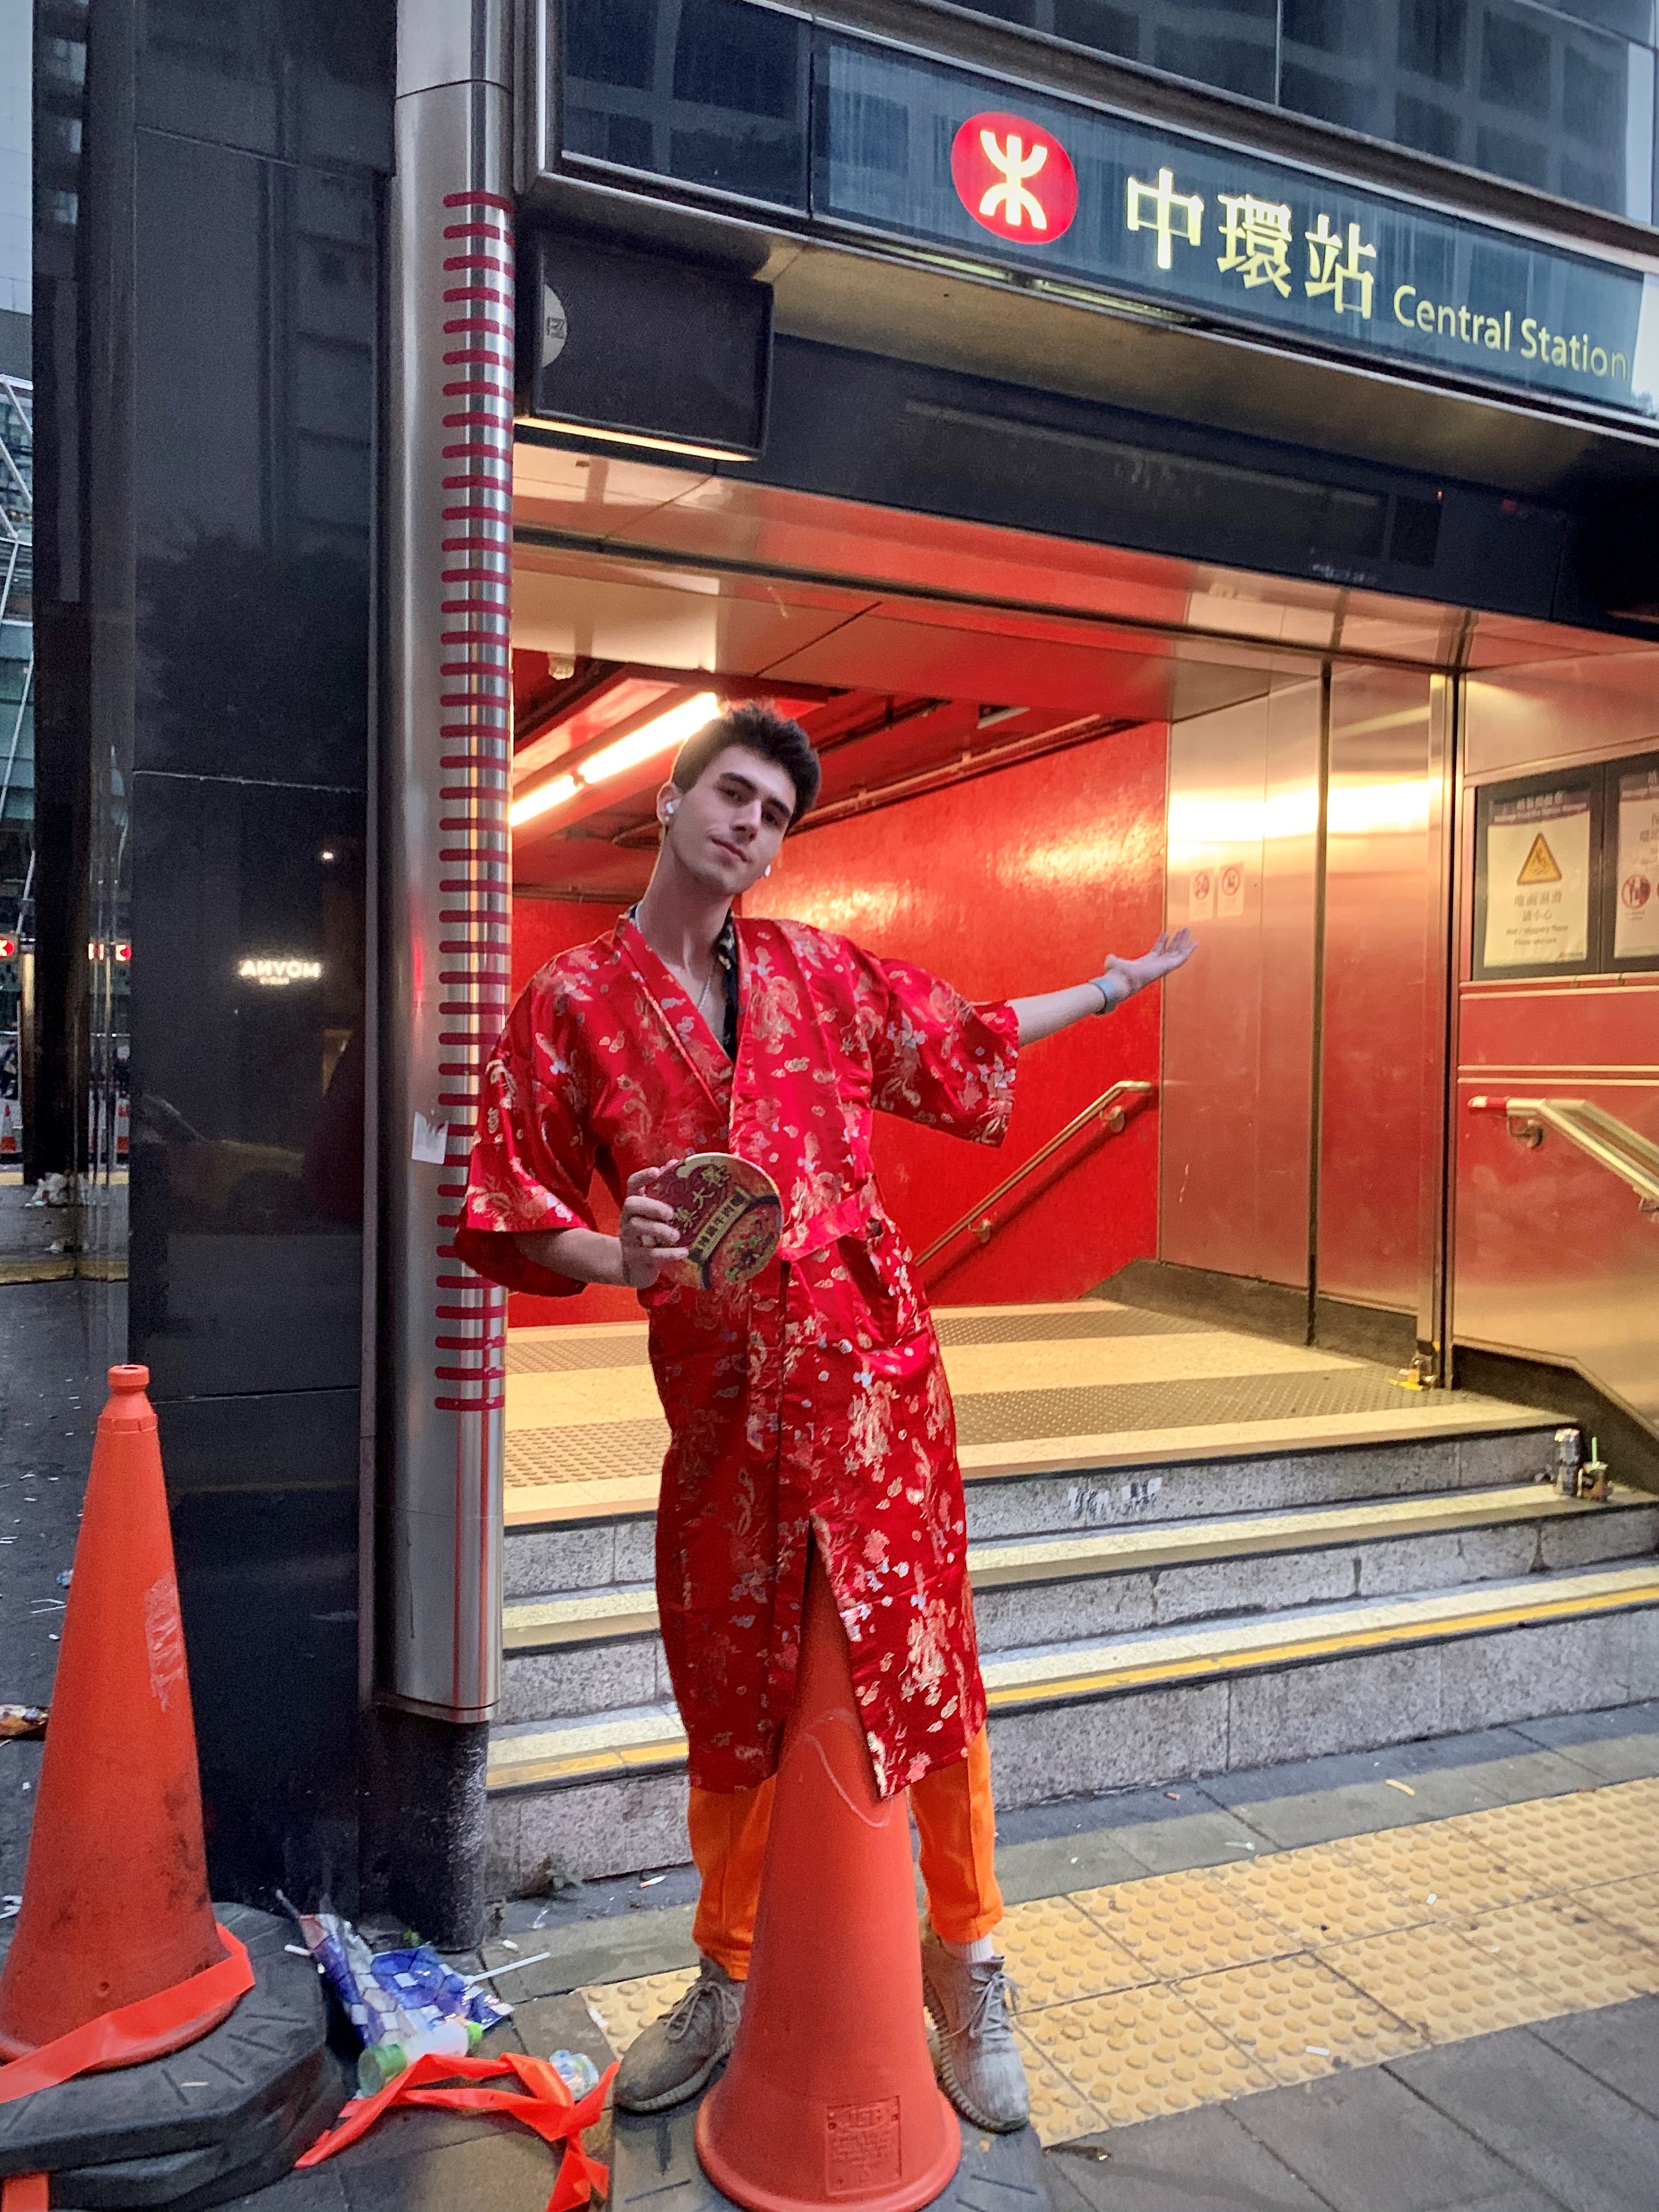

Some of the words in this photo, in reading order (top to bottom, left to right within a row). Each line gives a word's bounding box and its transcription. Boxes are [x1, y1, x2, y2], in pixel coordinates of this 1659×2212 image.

[1126, 167, 1377, 320] 中環站
[1393, 284, 1511, 353] Central
[1520, 317, 1628, 380] Station
